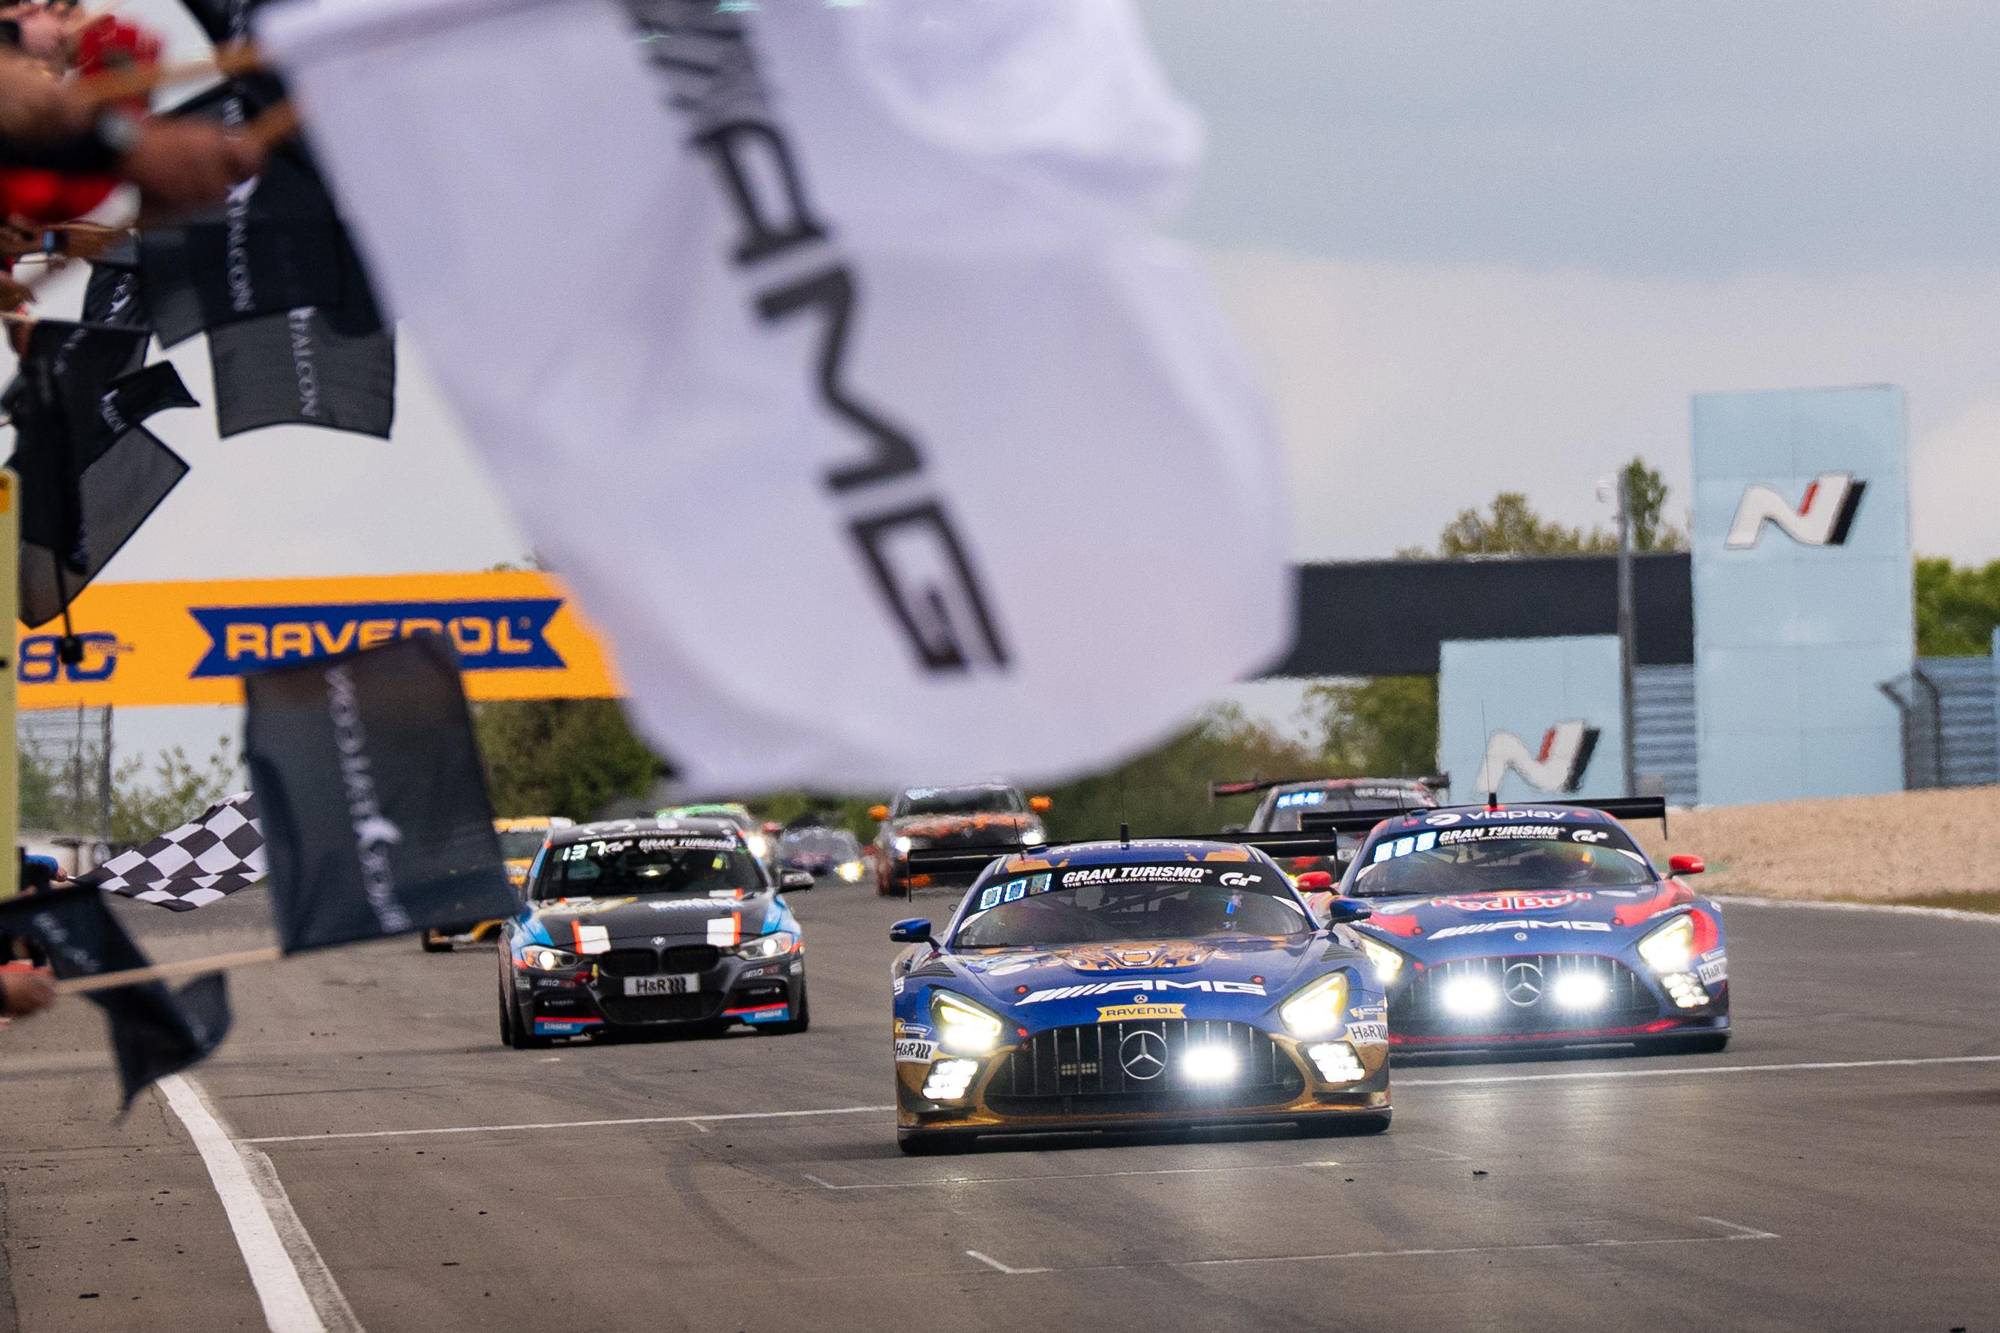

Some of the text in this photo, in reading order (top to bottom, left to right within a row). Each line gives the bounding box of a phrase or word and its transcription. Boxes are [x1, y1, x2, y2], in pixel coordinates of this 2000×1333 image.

[289, 321, 318, 418] FALCON
[1466, 809, 1567, 821] viaplay
[1438, 825, 1560, 842] GRAN TURISMO
[562, 840, 606, 862] 137
[638, 838, 677, 850] GRAN
[1062, 866, 1205, 884] GRAN TURISMO
[1148, 876, 1202, 884] SIMULATOR
[636, 978, 666, 992] H&R
[1106, 1006, 1177, 1017] RAVENOL
[1350, 1026, 1377, 1040] H&R
[896, 1042, 915, 1057] H&R
